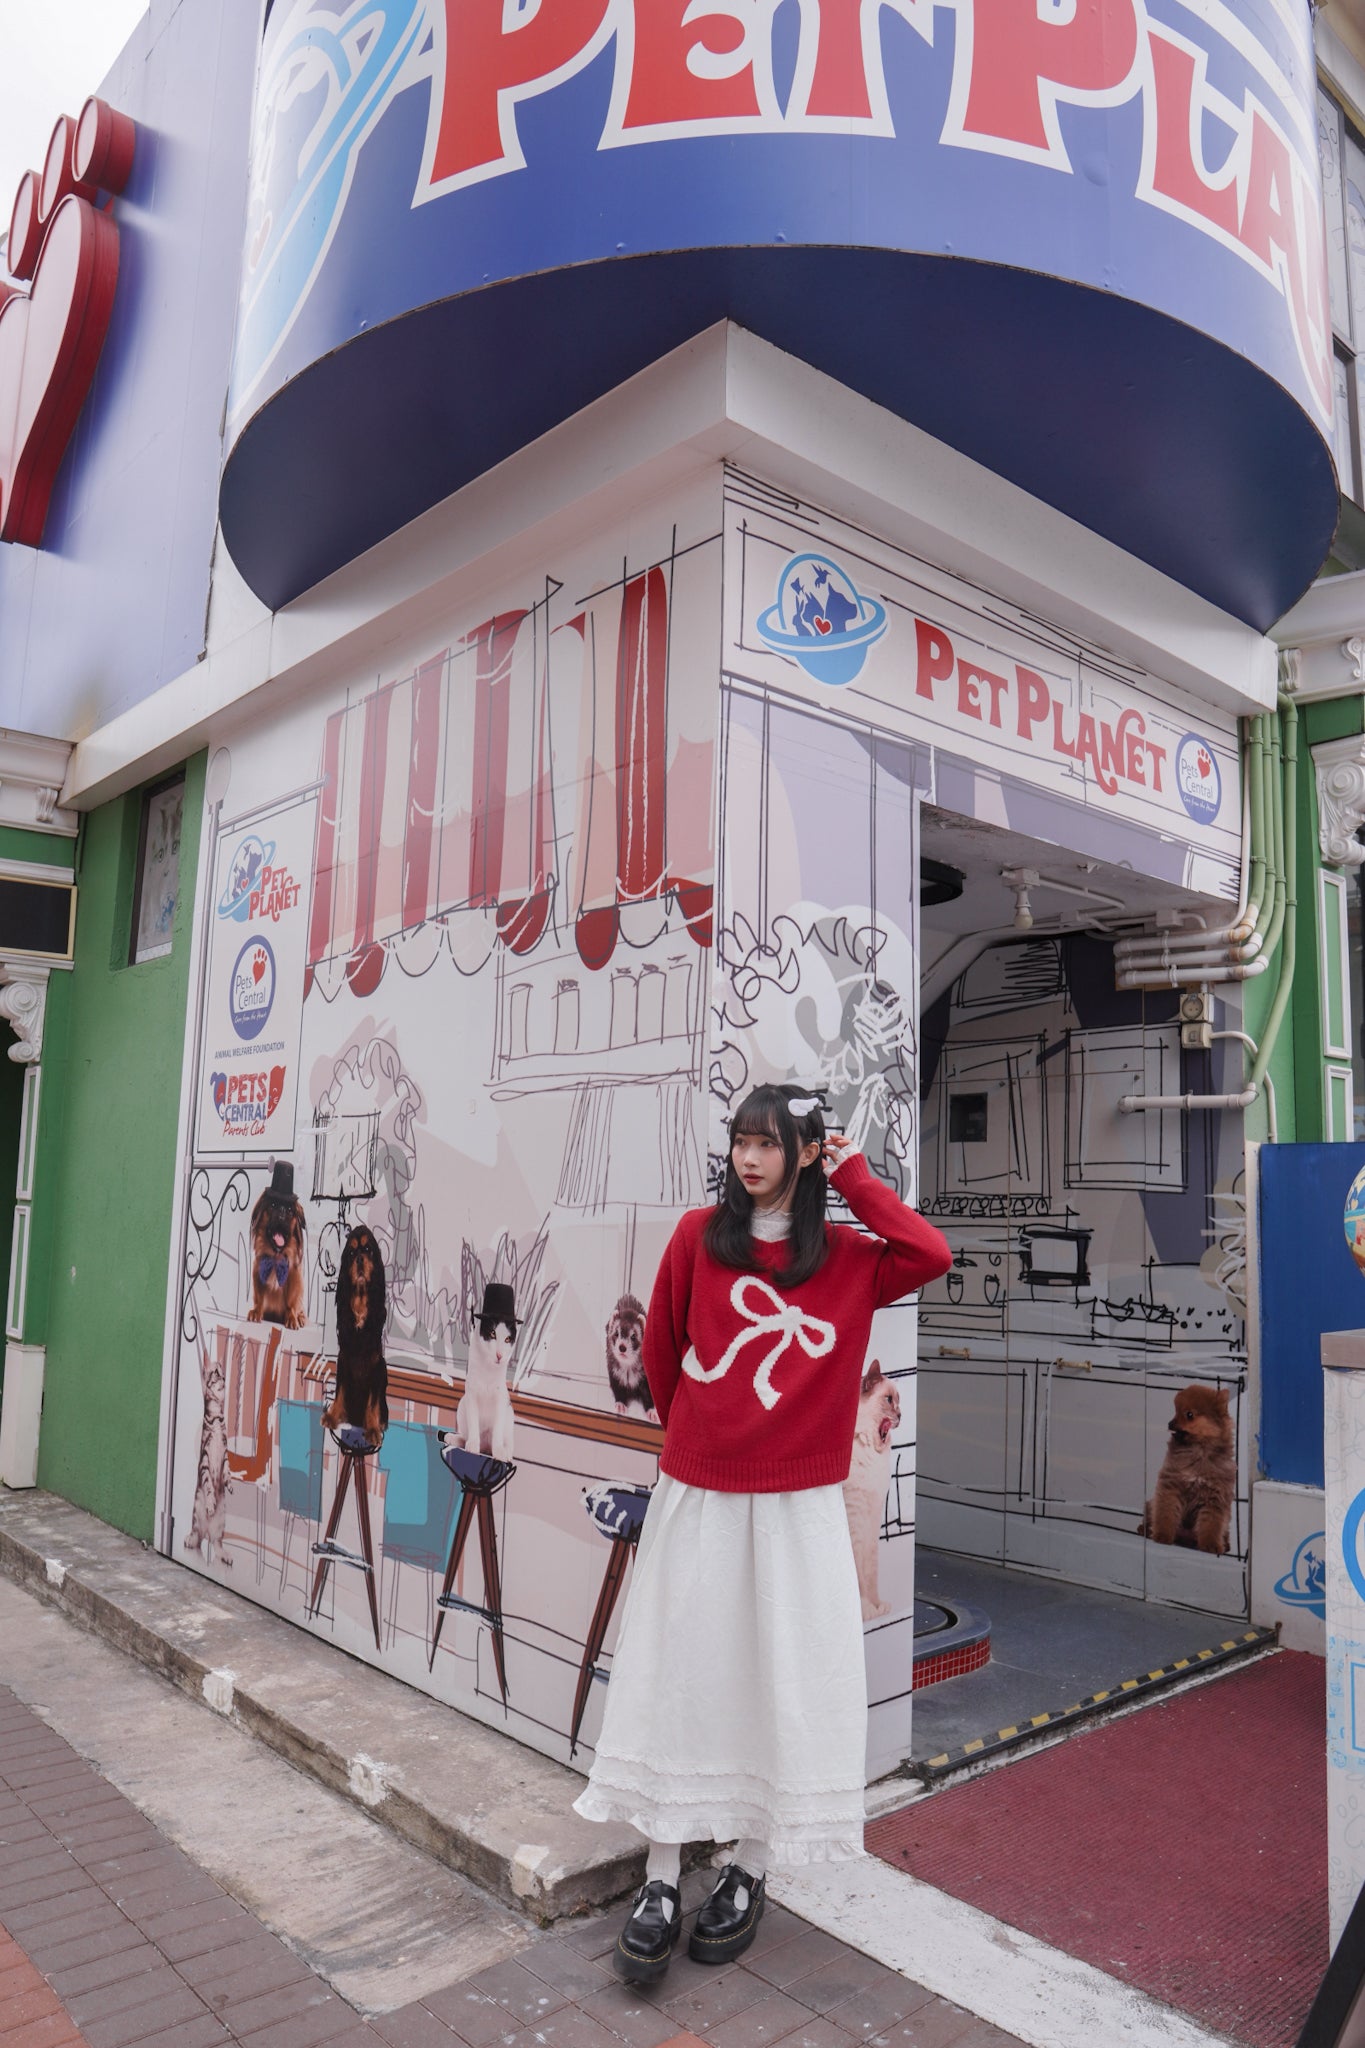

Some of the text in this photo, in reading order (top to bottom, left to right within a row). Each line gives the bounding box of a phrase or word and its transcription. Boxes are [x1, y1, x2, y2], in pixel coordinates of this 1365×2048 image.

[914, 618, 1167, 796] PET PLANET
[1181, 758, 1198, 778] Pets
[1185, 775, 1213, 799] Central
[260, 866, 288, 895] PET
[248, 875, 301, 923] PLANET
[235, 975, 252, 995] Pets
[238, 987, 266, 1010] Central
[214, 1041, 285, 1059] ANIMAL WELFARE FOUNDATION
[227, 1072, 268, 1105] PETS
[224, 1102, 267, 1122] CENTRAL
[223, 1119, 266, 1137] Parents Club
